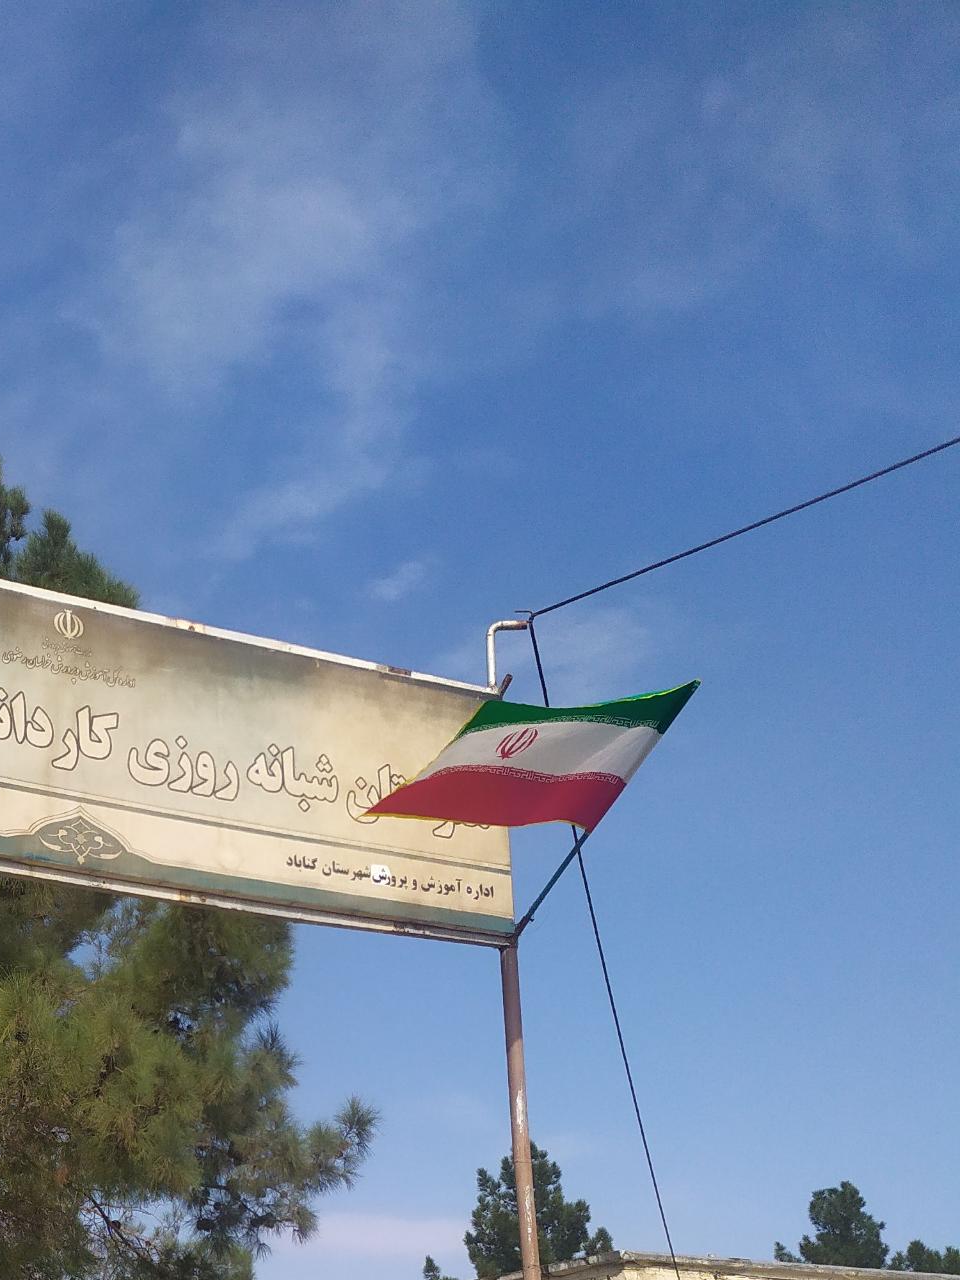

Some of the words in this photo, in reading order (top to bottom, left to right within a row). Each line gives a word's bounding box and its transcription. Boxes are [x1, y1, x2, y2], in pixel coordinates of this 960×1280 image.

[127, 735, 240, 801] روزی
[247, 743, 339, 813] شبانه
[286, 854, 318, 872] گناباد
[372, 867, 408, 889] پرورش
[411, 878, 418, 891] و
[420, 876, 463, 895] آموزش
[466, 884, 495, 900] اداره
